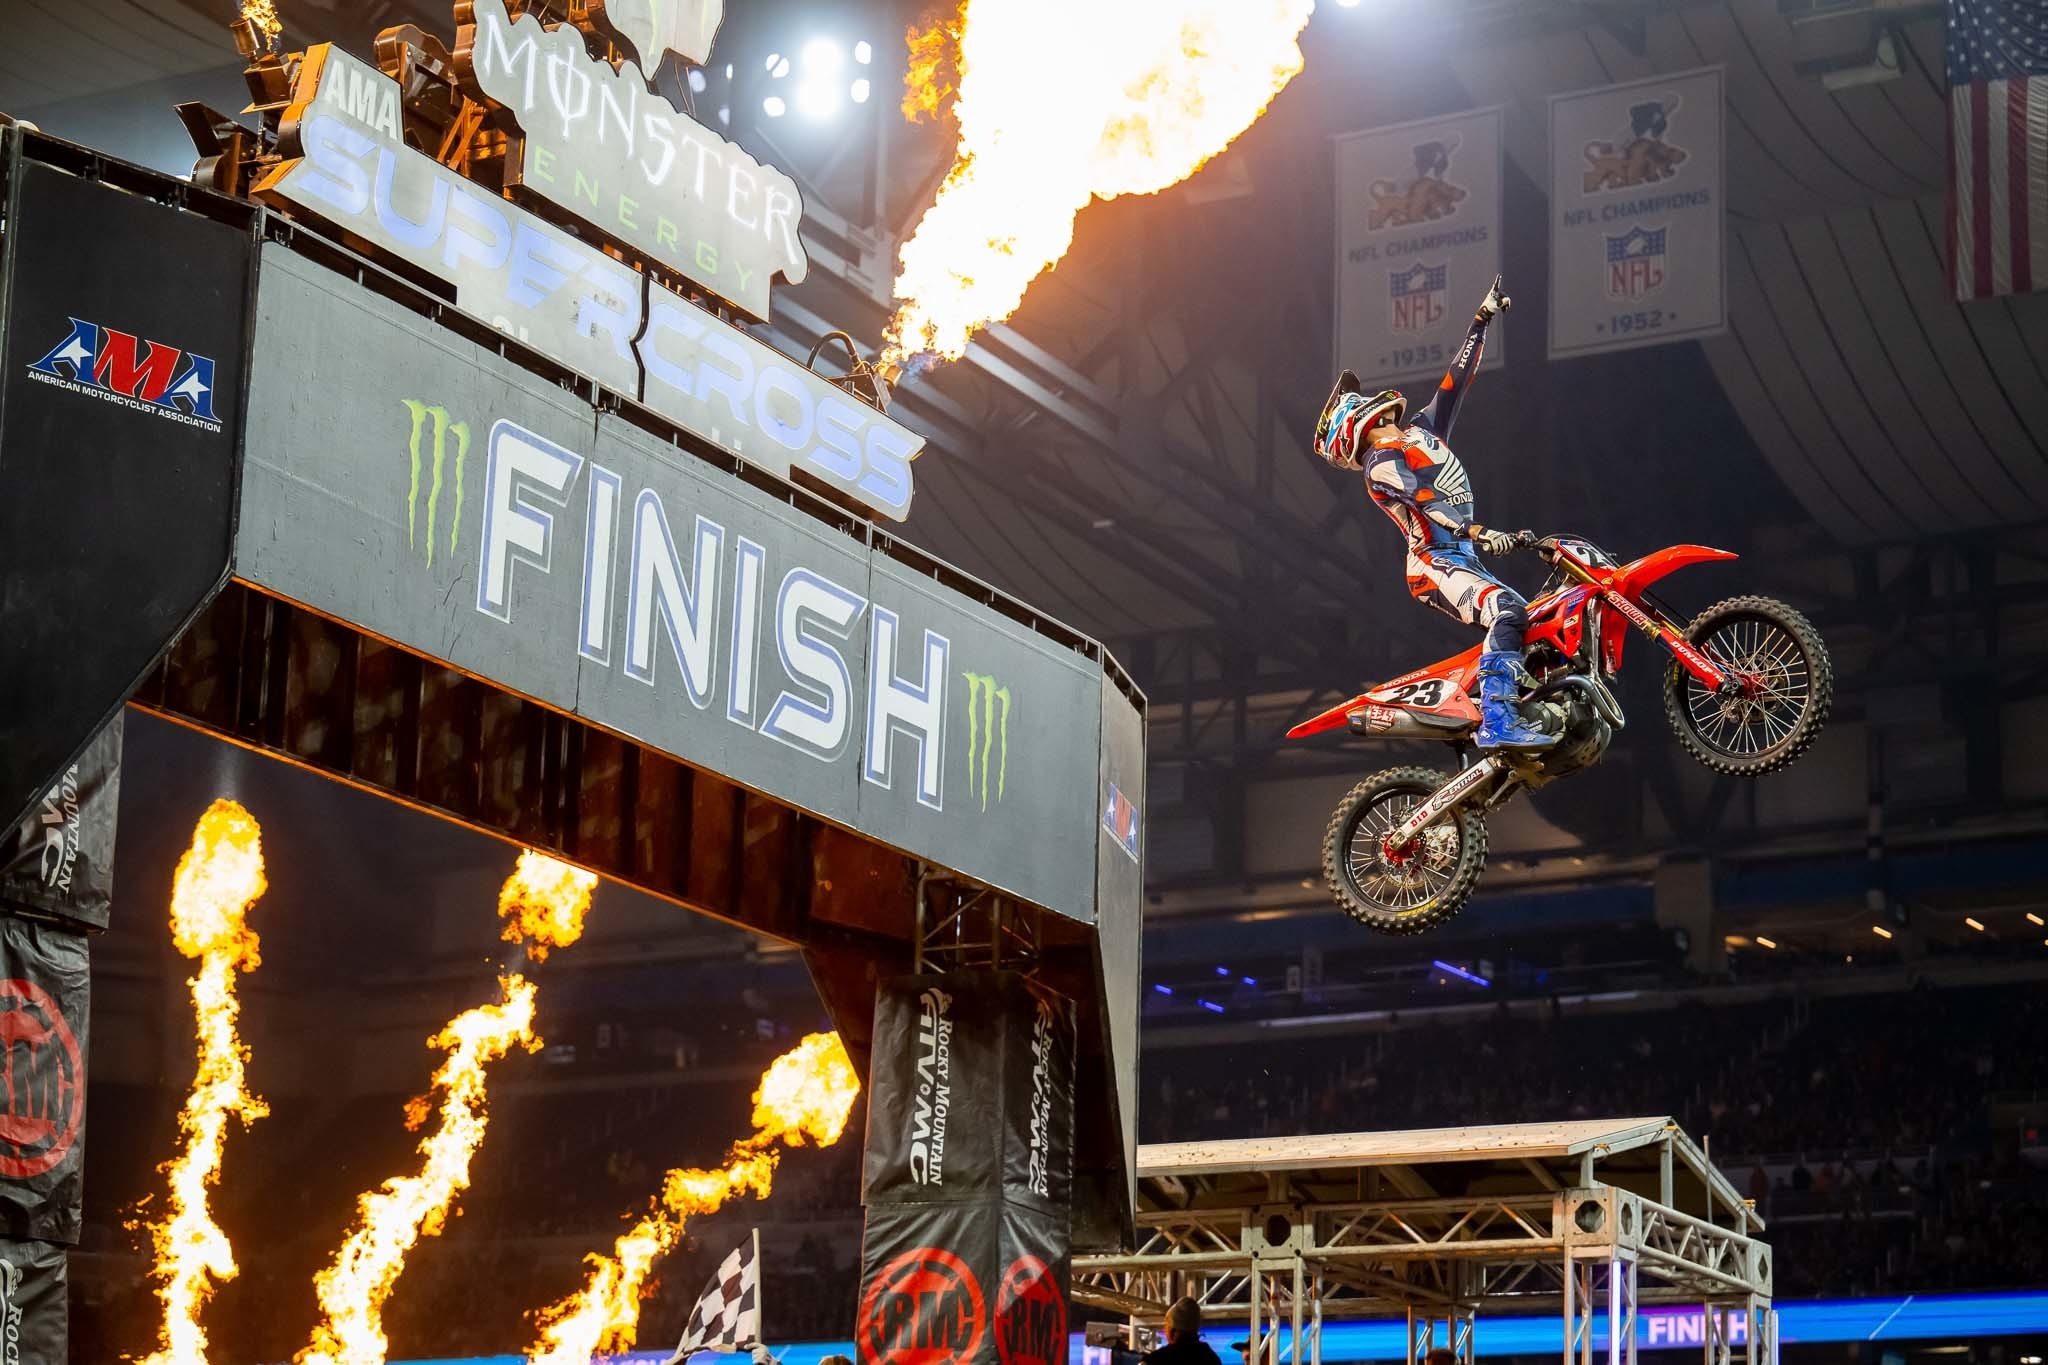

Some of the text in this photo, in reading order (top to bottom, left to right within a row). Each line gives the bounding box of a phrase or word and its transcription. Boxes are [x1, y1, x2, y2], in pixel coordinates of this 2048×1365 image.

[322, 58, 400, 142] AMA
[484, 12, 802, 265] MONSTER
[531, 145, 755, 292] ENERGY
[1564, 189, 1711, 227] NFL CHAMPIONS
[1348, 225, 1488, 263] NFL CHAMPIONS
[1611, 257, 1665, 295] NFL
[292, 113, 918, 508] SUPERCROSS
[1392, 292, 1443, 330] NFL
[1610, 309, 1663, 335] 1952
[26, 316, 224, 424] AMA
[1392, 343, 1443, 368] 1935
[27, 370, 221, 434] AMERICAN MOTORCYCLIST ASSOCIATION
[475, 418, 952, 812] FINISH
[1609, 592, 1648, 629] SHOWA
[1670, 641, 1714, 673] DUNLOP
[1381, 670, 1430, 689] HONDA
[1384, 679, 1445, 707] 23
[929, 1017, 953, 1187] ROCKY MOUNTAIN
[1039, 1032, 1054, 1199] ROCKY MOUNTAIN
